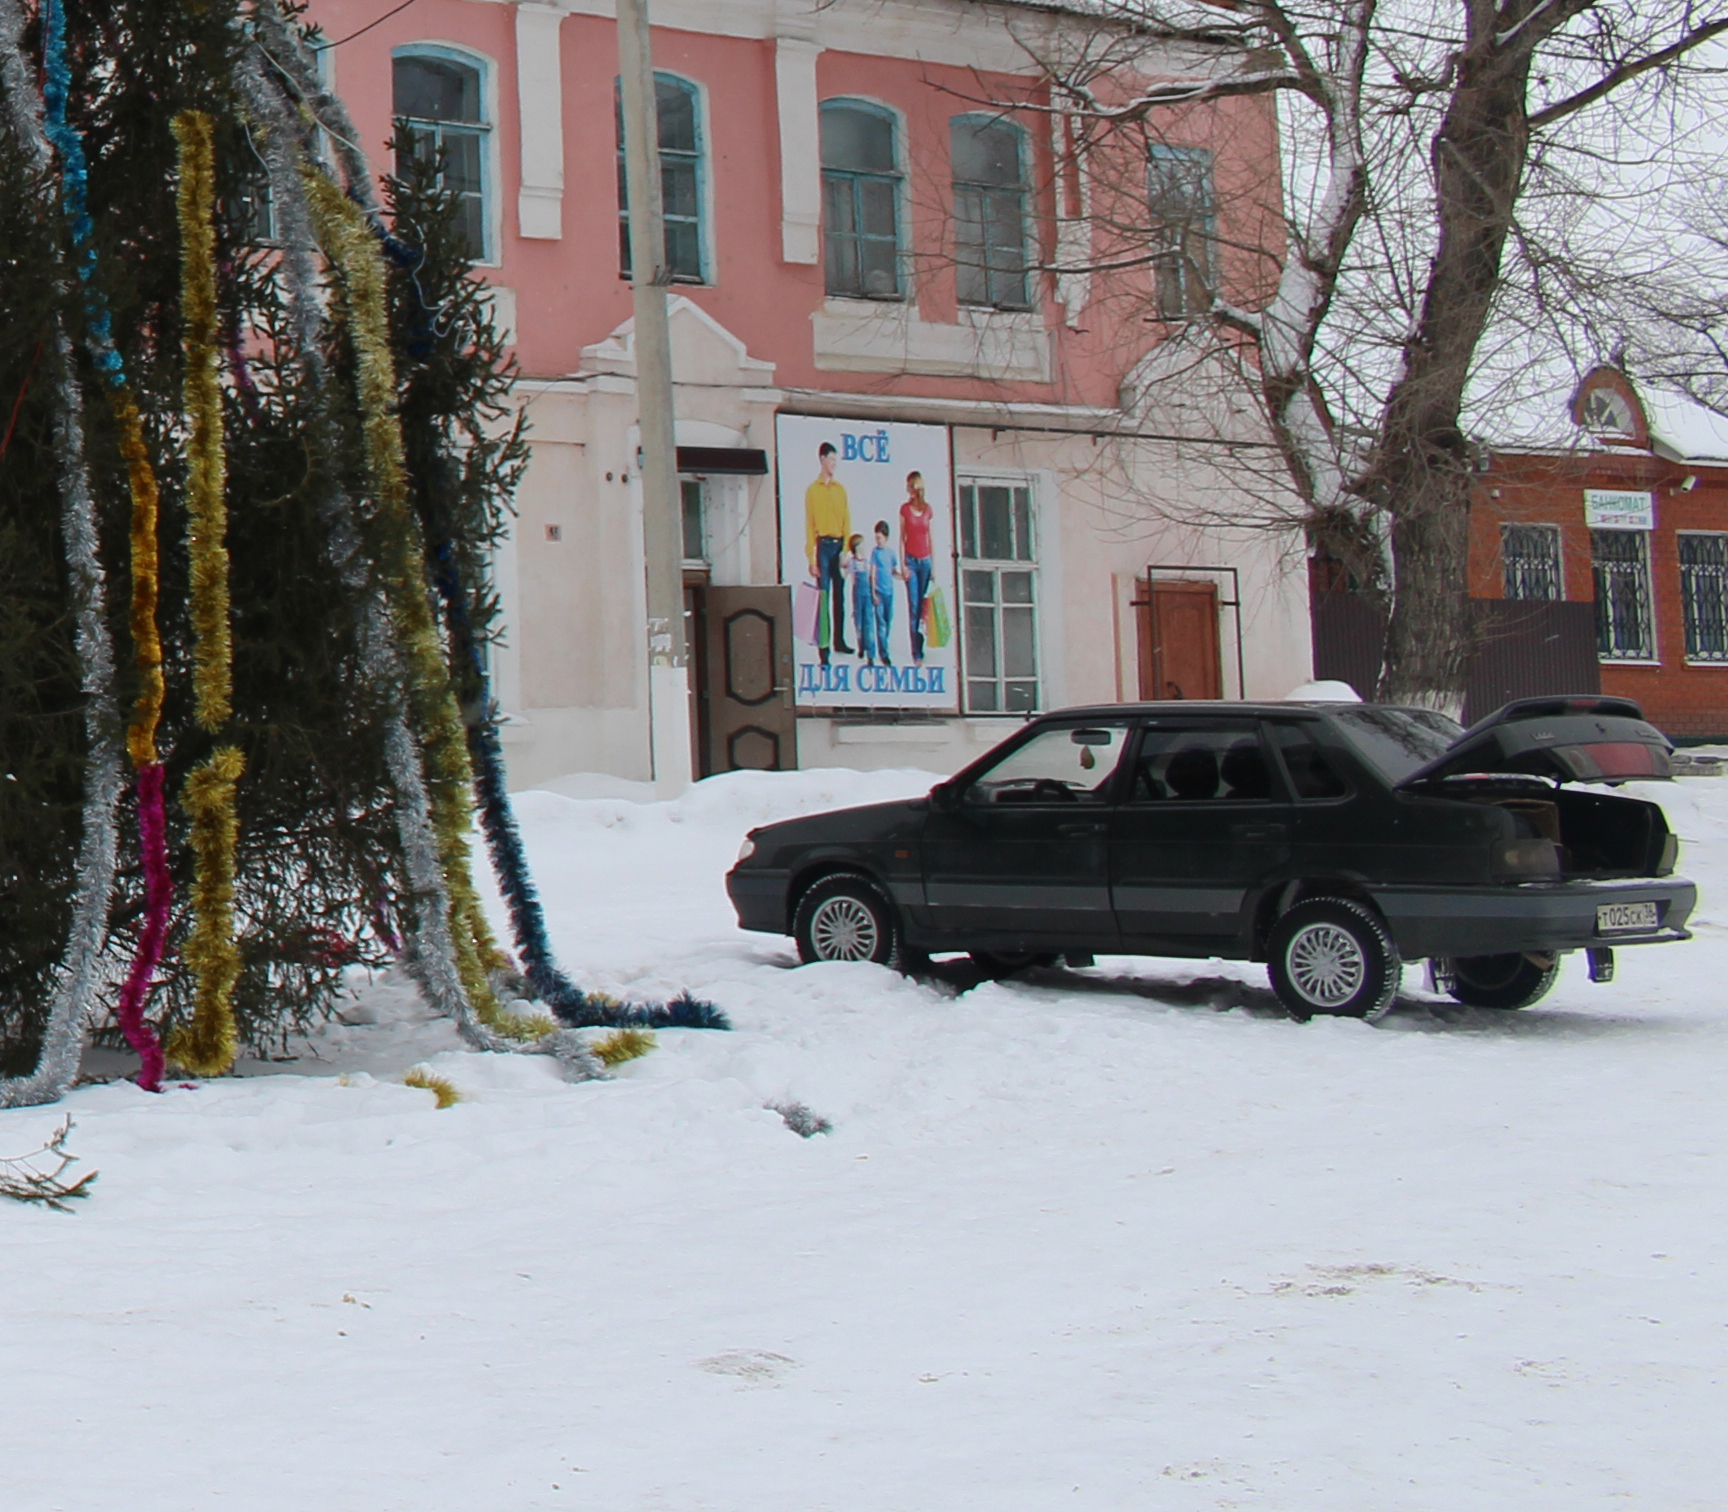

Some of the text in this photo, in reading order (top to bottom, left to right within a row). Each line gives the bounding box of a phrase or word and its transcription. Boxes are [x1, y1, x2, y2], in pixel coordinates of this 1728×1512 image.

[841, 429, 891, 463] ВСЁ
[798, 664, 946, 698] ДЛЯ СЕМЬИ
